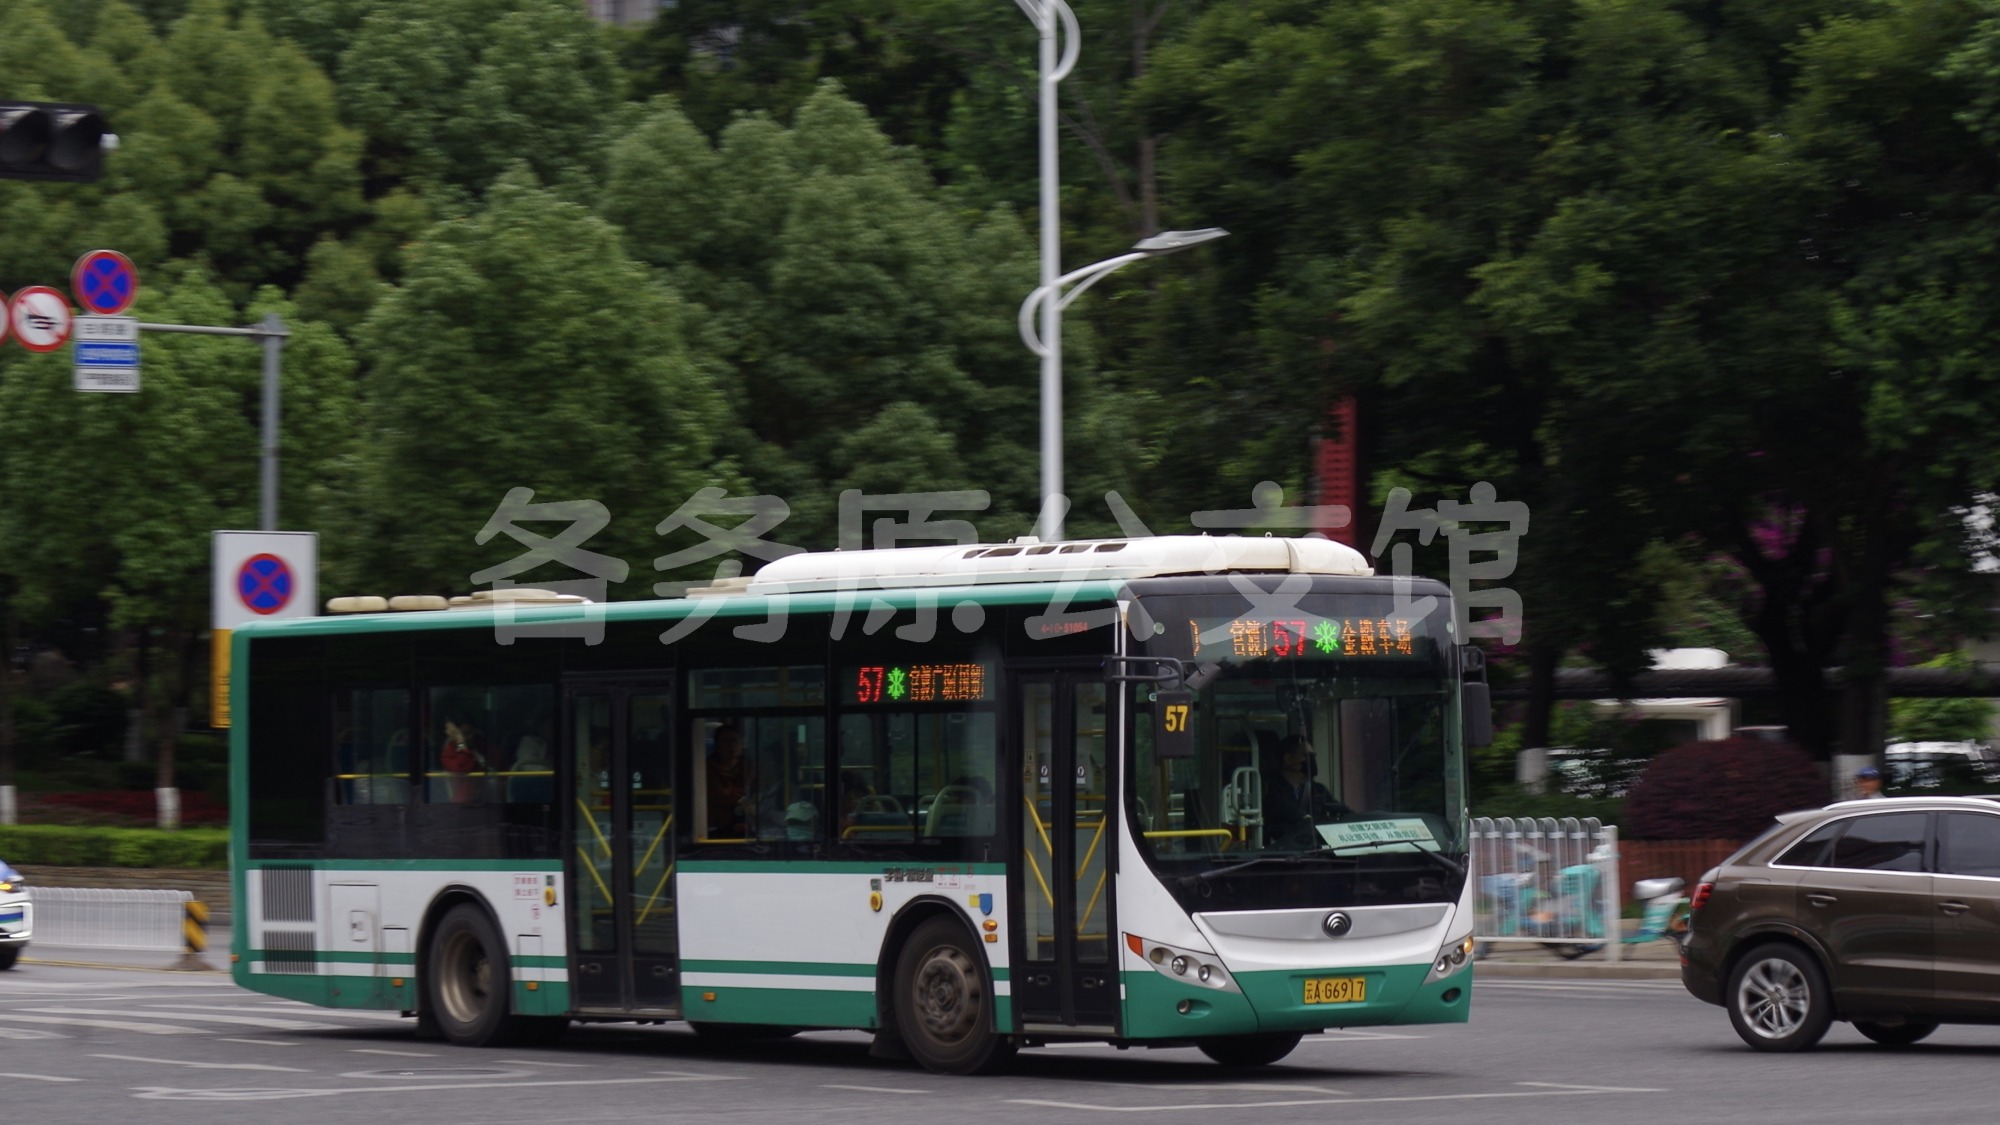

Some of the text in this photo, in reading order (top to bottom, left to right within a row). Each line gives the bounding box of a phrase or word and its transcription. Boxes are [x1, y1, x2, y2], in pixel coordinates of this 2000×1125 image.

[1273, 620, 1307, 656] 57
[858, 667, 884, 702] 57
[1165, 705, 1188, 732] 57
